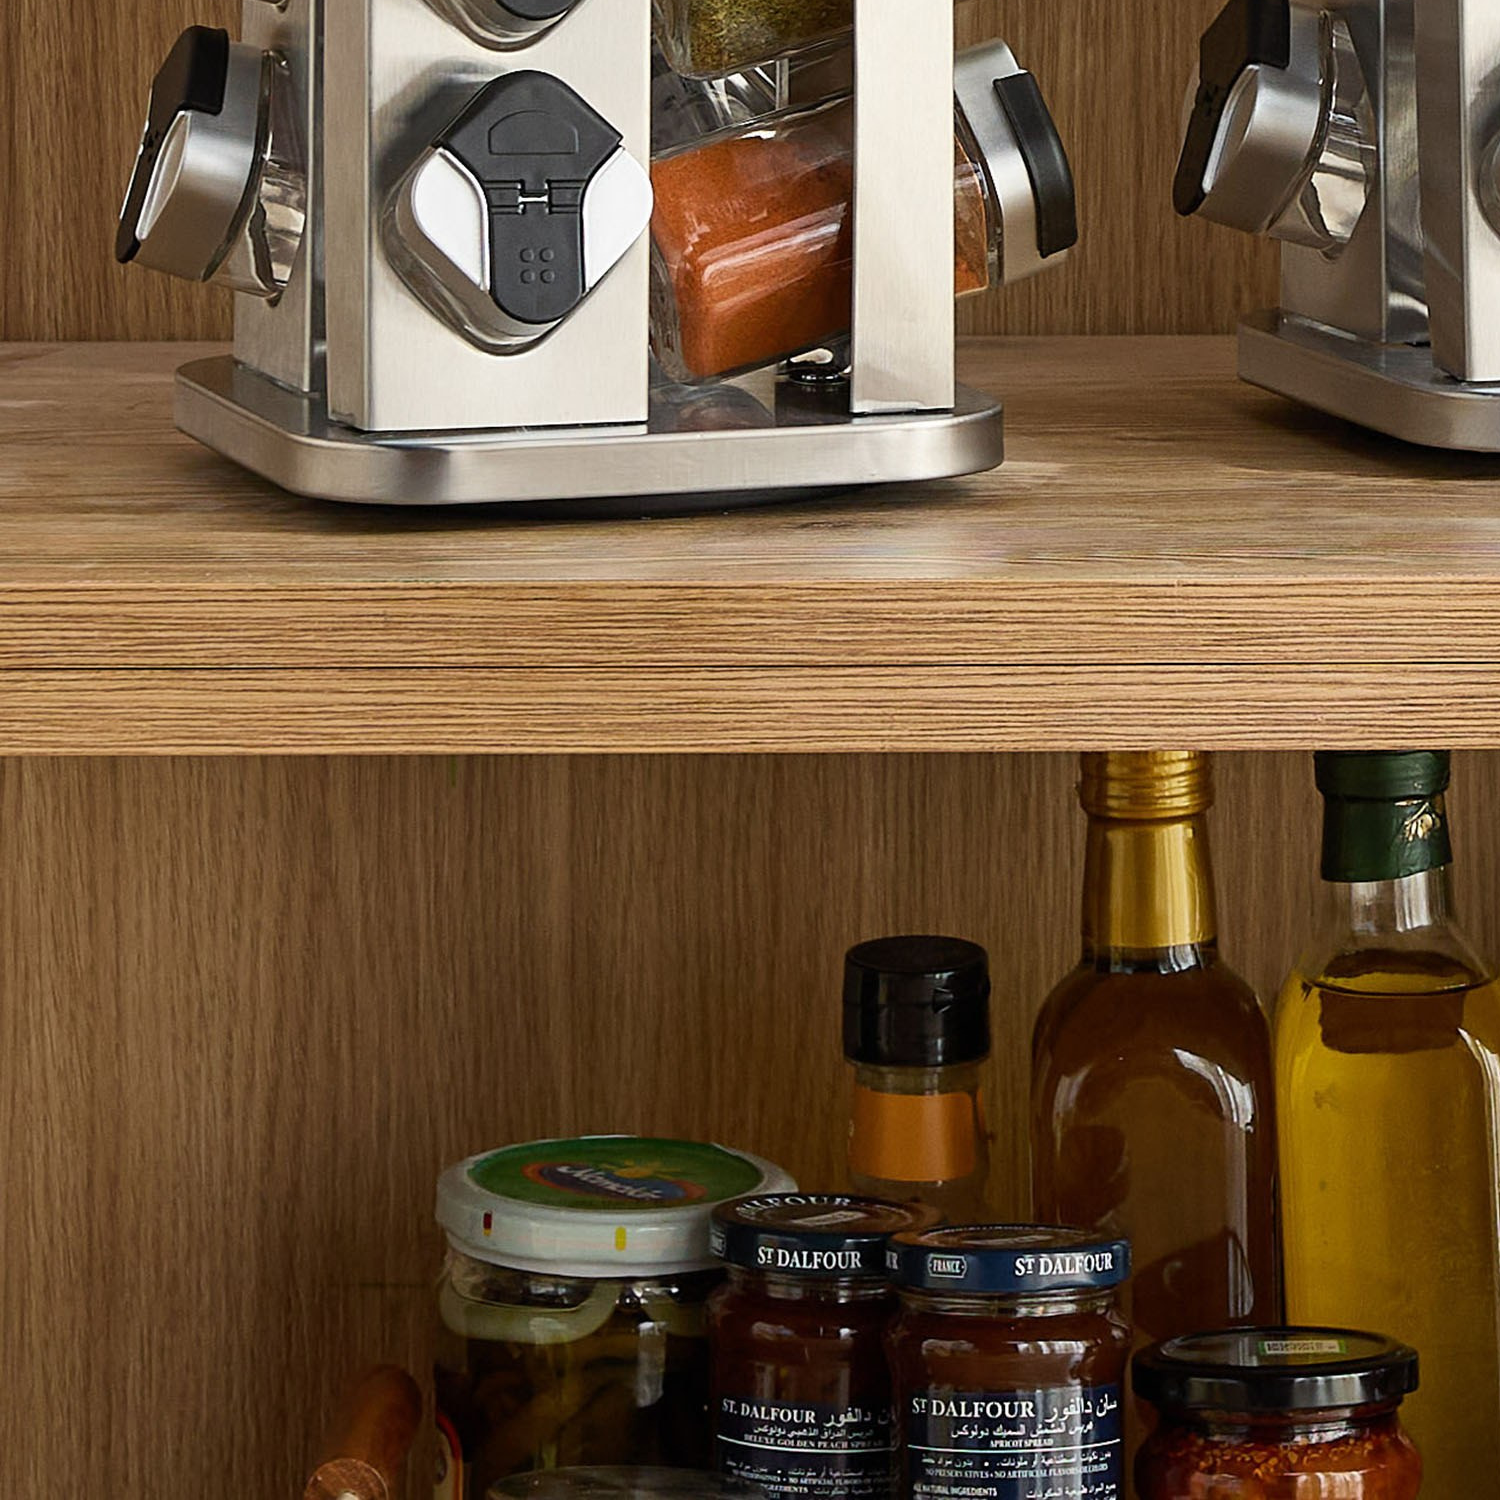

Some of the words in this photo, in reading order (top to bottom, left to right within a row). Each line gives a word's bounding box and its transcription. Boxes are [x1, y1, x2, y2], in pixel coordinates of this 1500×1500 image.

[776, 1249, 864, 1271] DALFOUR
[932, 1259, 961, 1274] FRANCE
[1038, 1251, 1114, 1277] DALFOUR
[740, 1402, 817, 1424] DALFOUR
[931, 1399, 1036, 1420] DALFOUR
[1044, 1396, 1093, 1424] دالفور
[1096, 1392, 1118, 1419] سان
[777, 1438, 815, 1449] GOLDEN
[817, 1440, 849, 1450] PEACH
[990, 1439, 1023, 1449] APRICOT
[1024, 1438, 1055, 1448] SPREAD
[935, 1468, 989, 1480] PRESERVATIVES
[994, 1470, 1006, 1480] NO
[1007, 1469, 1048, 1480] ARTIFICIAL
[950, 1486, 998, 1498] INGREDIENTS
